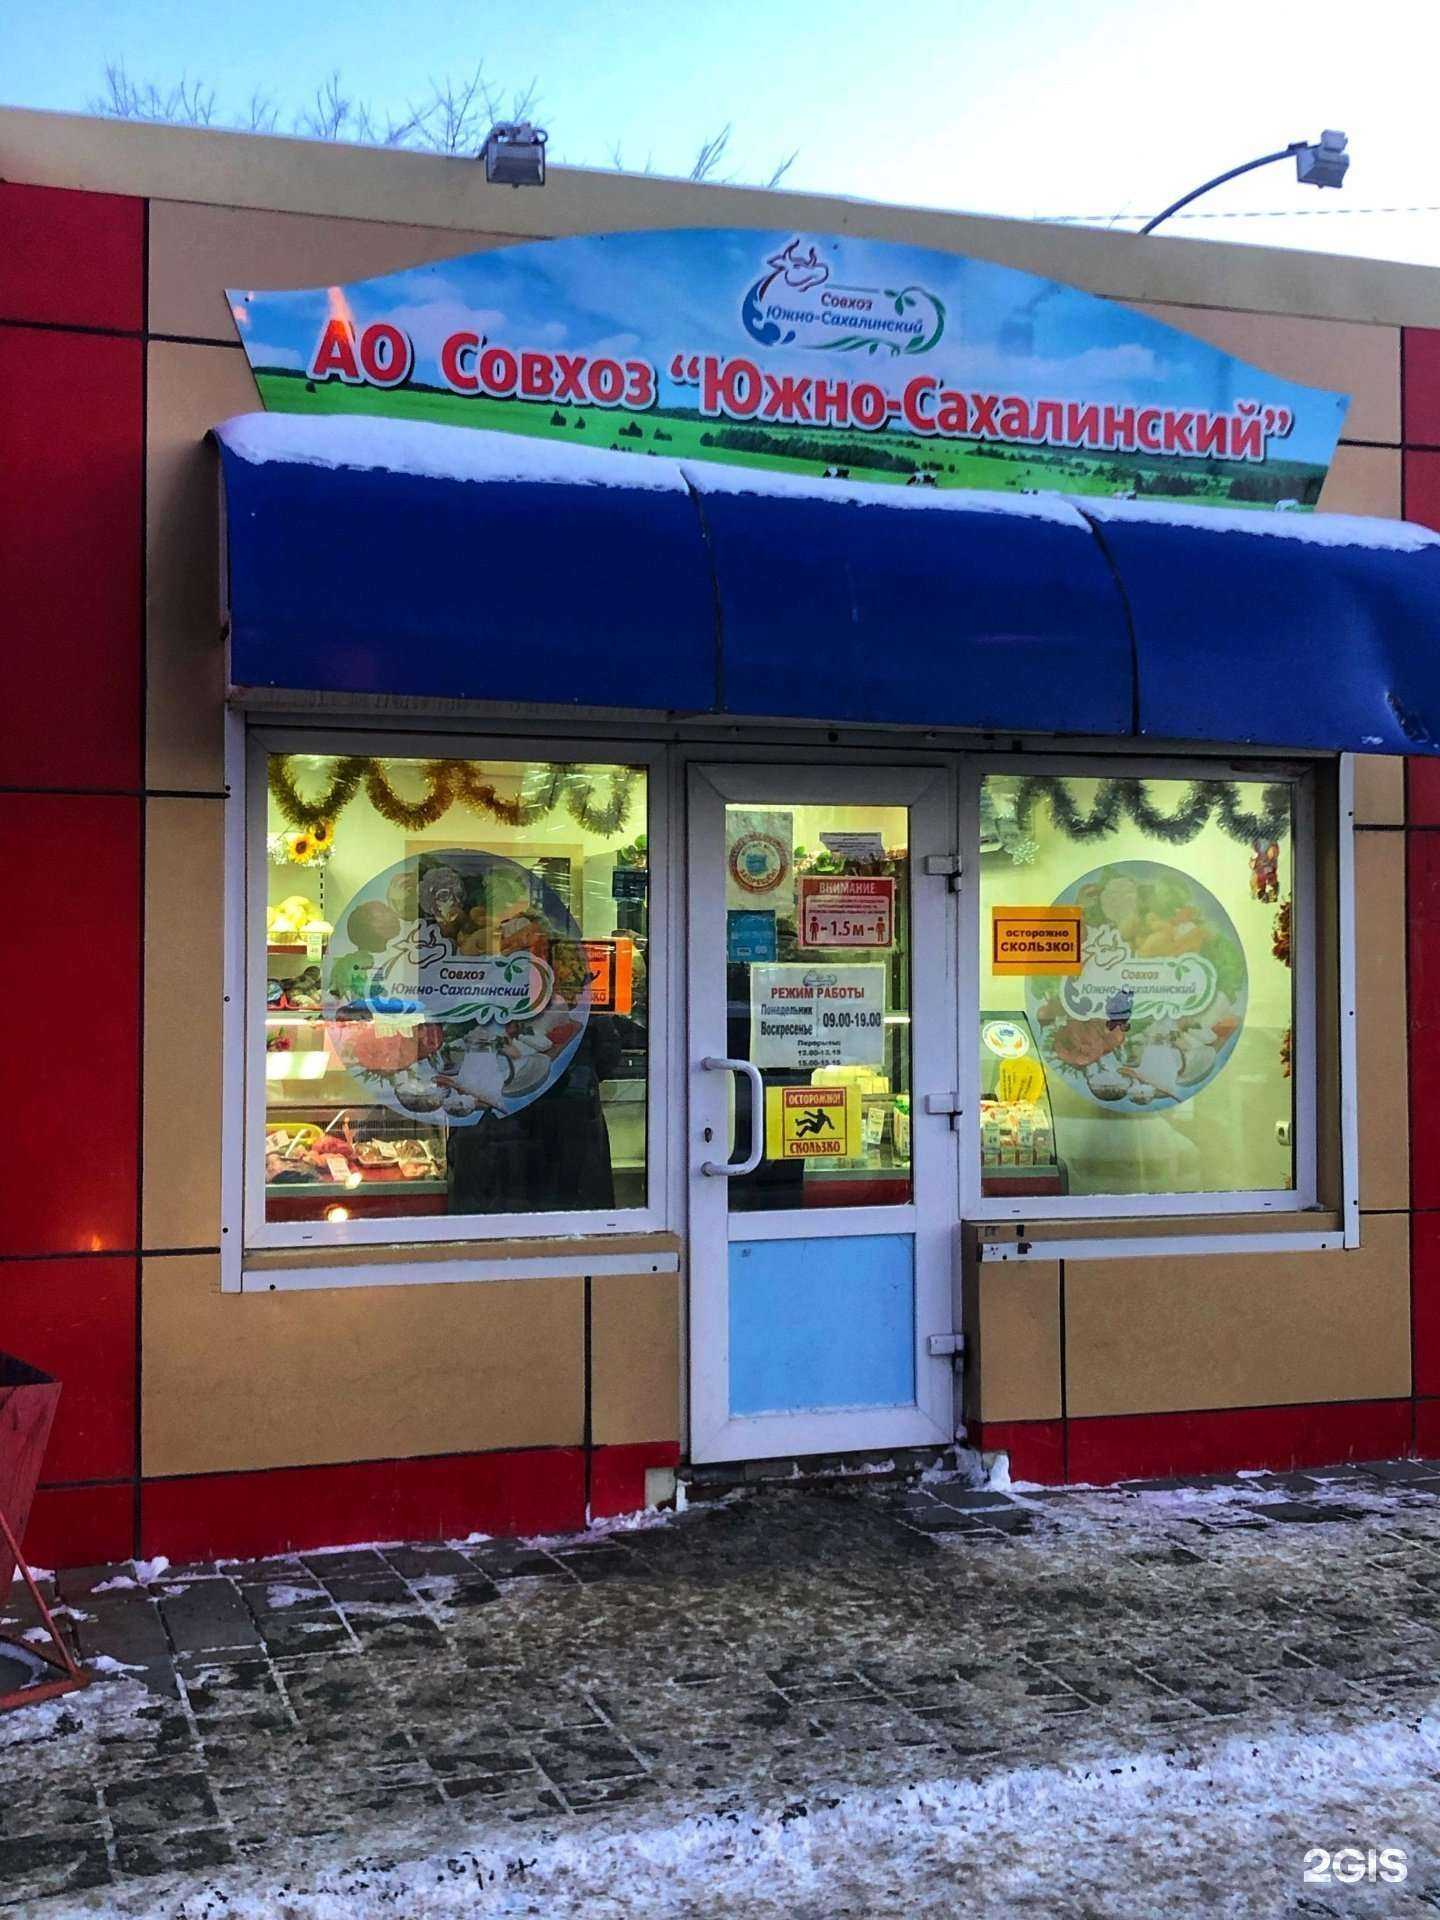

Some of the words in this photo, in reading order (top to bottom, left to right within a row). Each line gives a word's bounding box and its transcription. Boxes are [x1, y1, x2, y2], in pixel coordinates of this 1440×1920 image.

[820, 291, 874, 312] Совхоз
[766, 304, 925, 335] Южно-Сахалинский
[312, 320, 407, 380] АО
[441, 332, 653, 403] Совхоз
[819, 881, 877, 895] ВНИМАНИЕ
[1005, 929, 1070, 940] осторожно
[999, 941, 1075, 954] СКОЛЬЗКО!
[439, 968, 486, 981] Совхоз
[1120, 969, 1160, 981] Совхоз
[390, 983, 531, 997] Южно-Сахалинский
[770, 987, 814, 1000] РЕЖИМ
[816, 986, 865, 999] РАБОТЫ
[760, 1004, 813, 1017] Понедельник
[822, 1012, 881, 1028] 09.00-19.00
[760, 1021, 813, 1038] Воскресенье
[788, 1094, 841, 1105] ОСТОРОЖНО!
[789, 1141, 841, 1154] СКОЛЬЗКО
